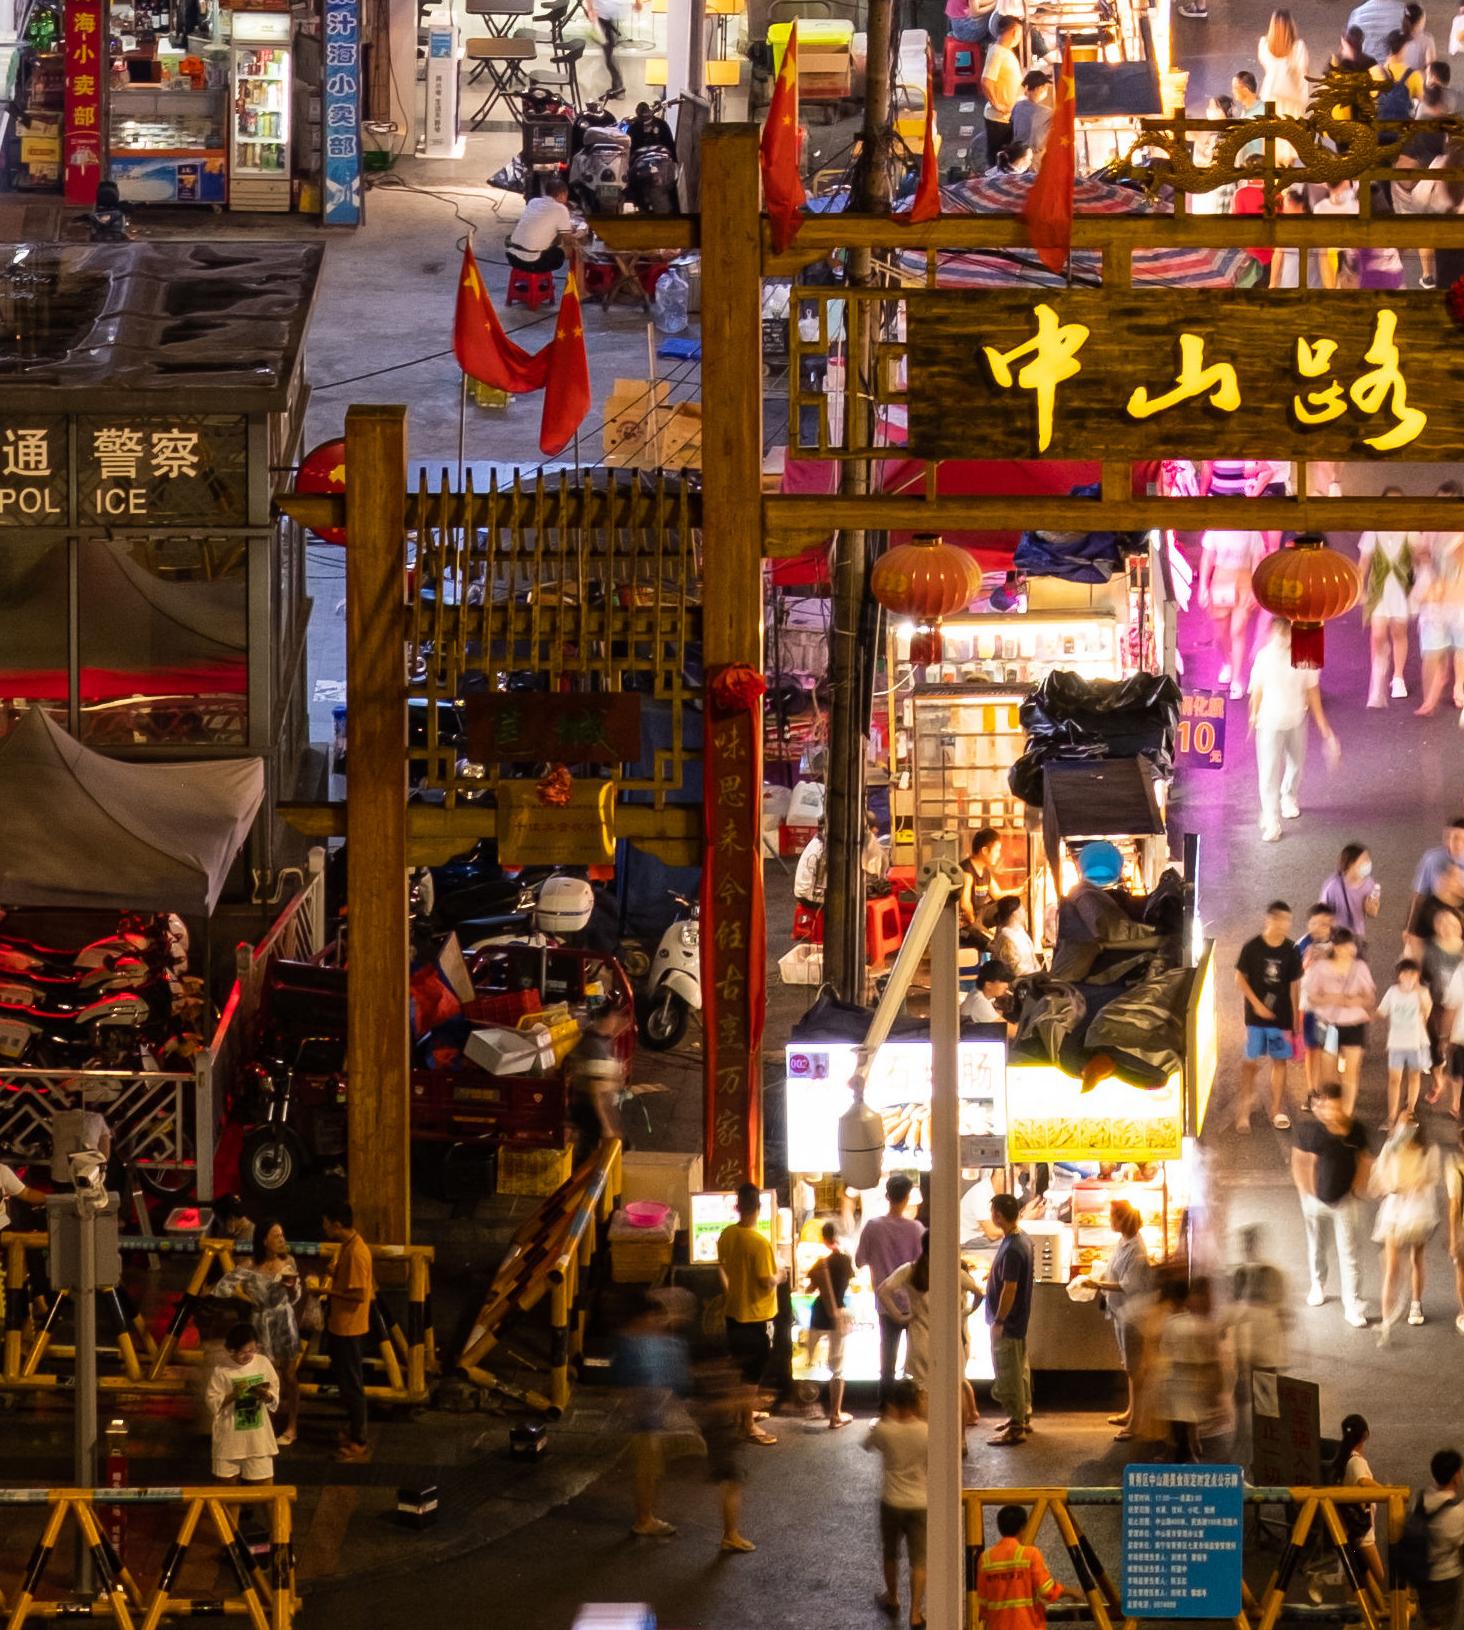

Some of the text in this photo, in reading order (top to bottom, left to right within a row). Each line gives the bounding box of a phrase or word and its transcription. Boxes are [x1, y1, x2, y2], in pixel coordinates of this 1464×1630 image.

[73, 0, 97, 127] 海小卖部
[326, 0, 357, 158] 汁海小卖部
[93, 427, 200, 480] 警察
